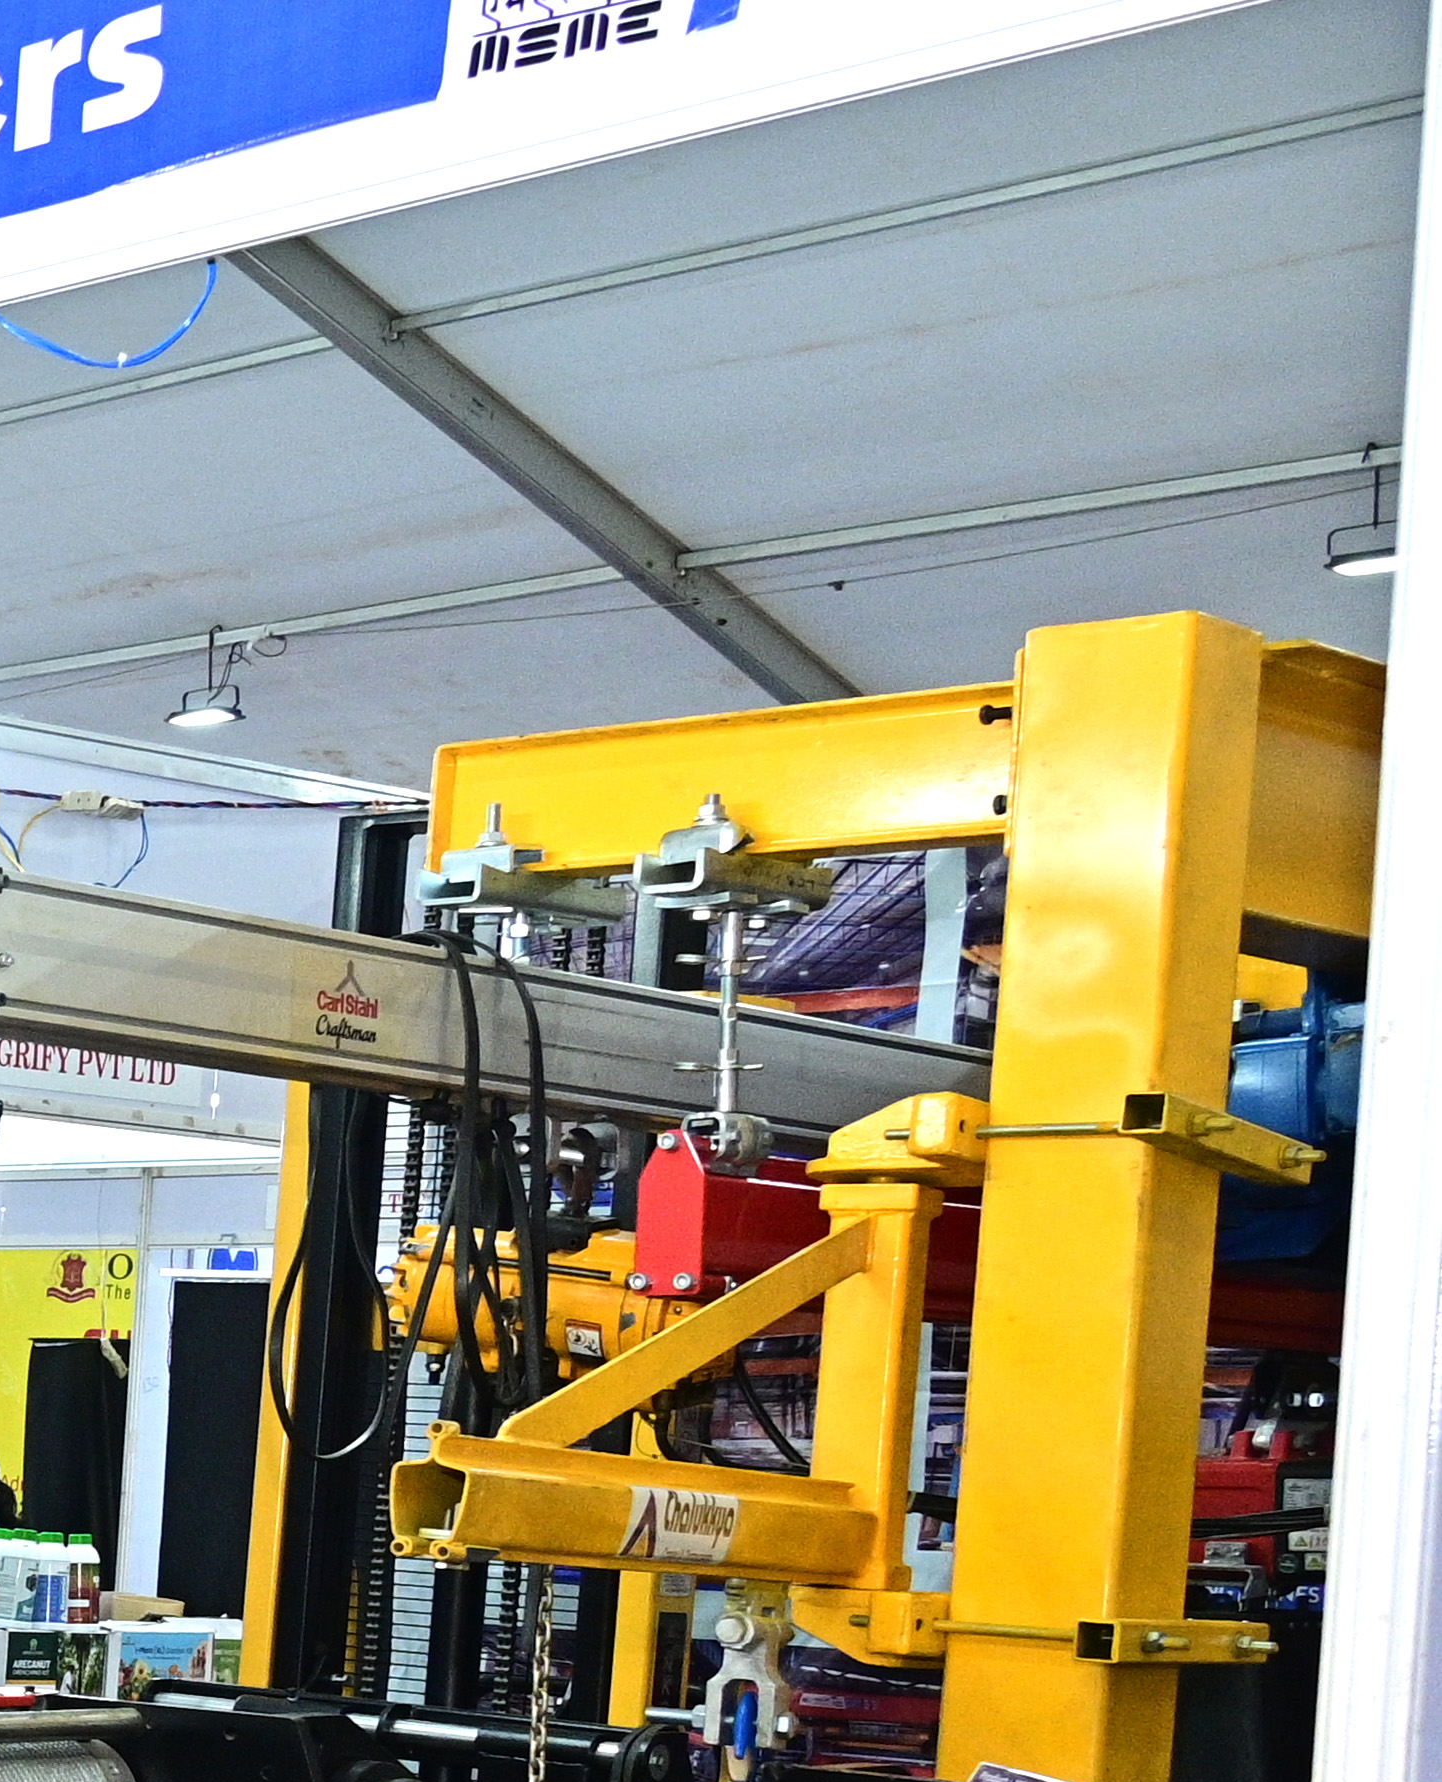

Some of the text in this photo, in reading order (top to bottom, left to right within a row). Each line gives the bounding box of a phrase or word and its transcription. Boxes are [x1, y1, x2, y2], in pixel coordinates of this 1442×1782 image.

[317, 990, 378, 1019] Carl Stahl
[316, 1014, 377, 1049] Craftsman
[77, 1050, 123, 1080] PVT
[130, 1058, 177, 1086] LTD
[106, 1284, 131, 1300] The
[664, 1490, 734, 1549] Chalukkya
